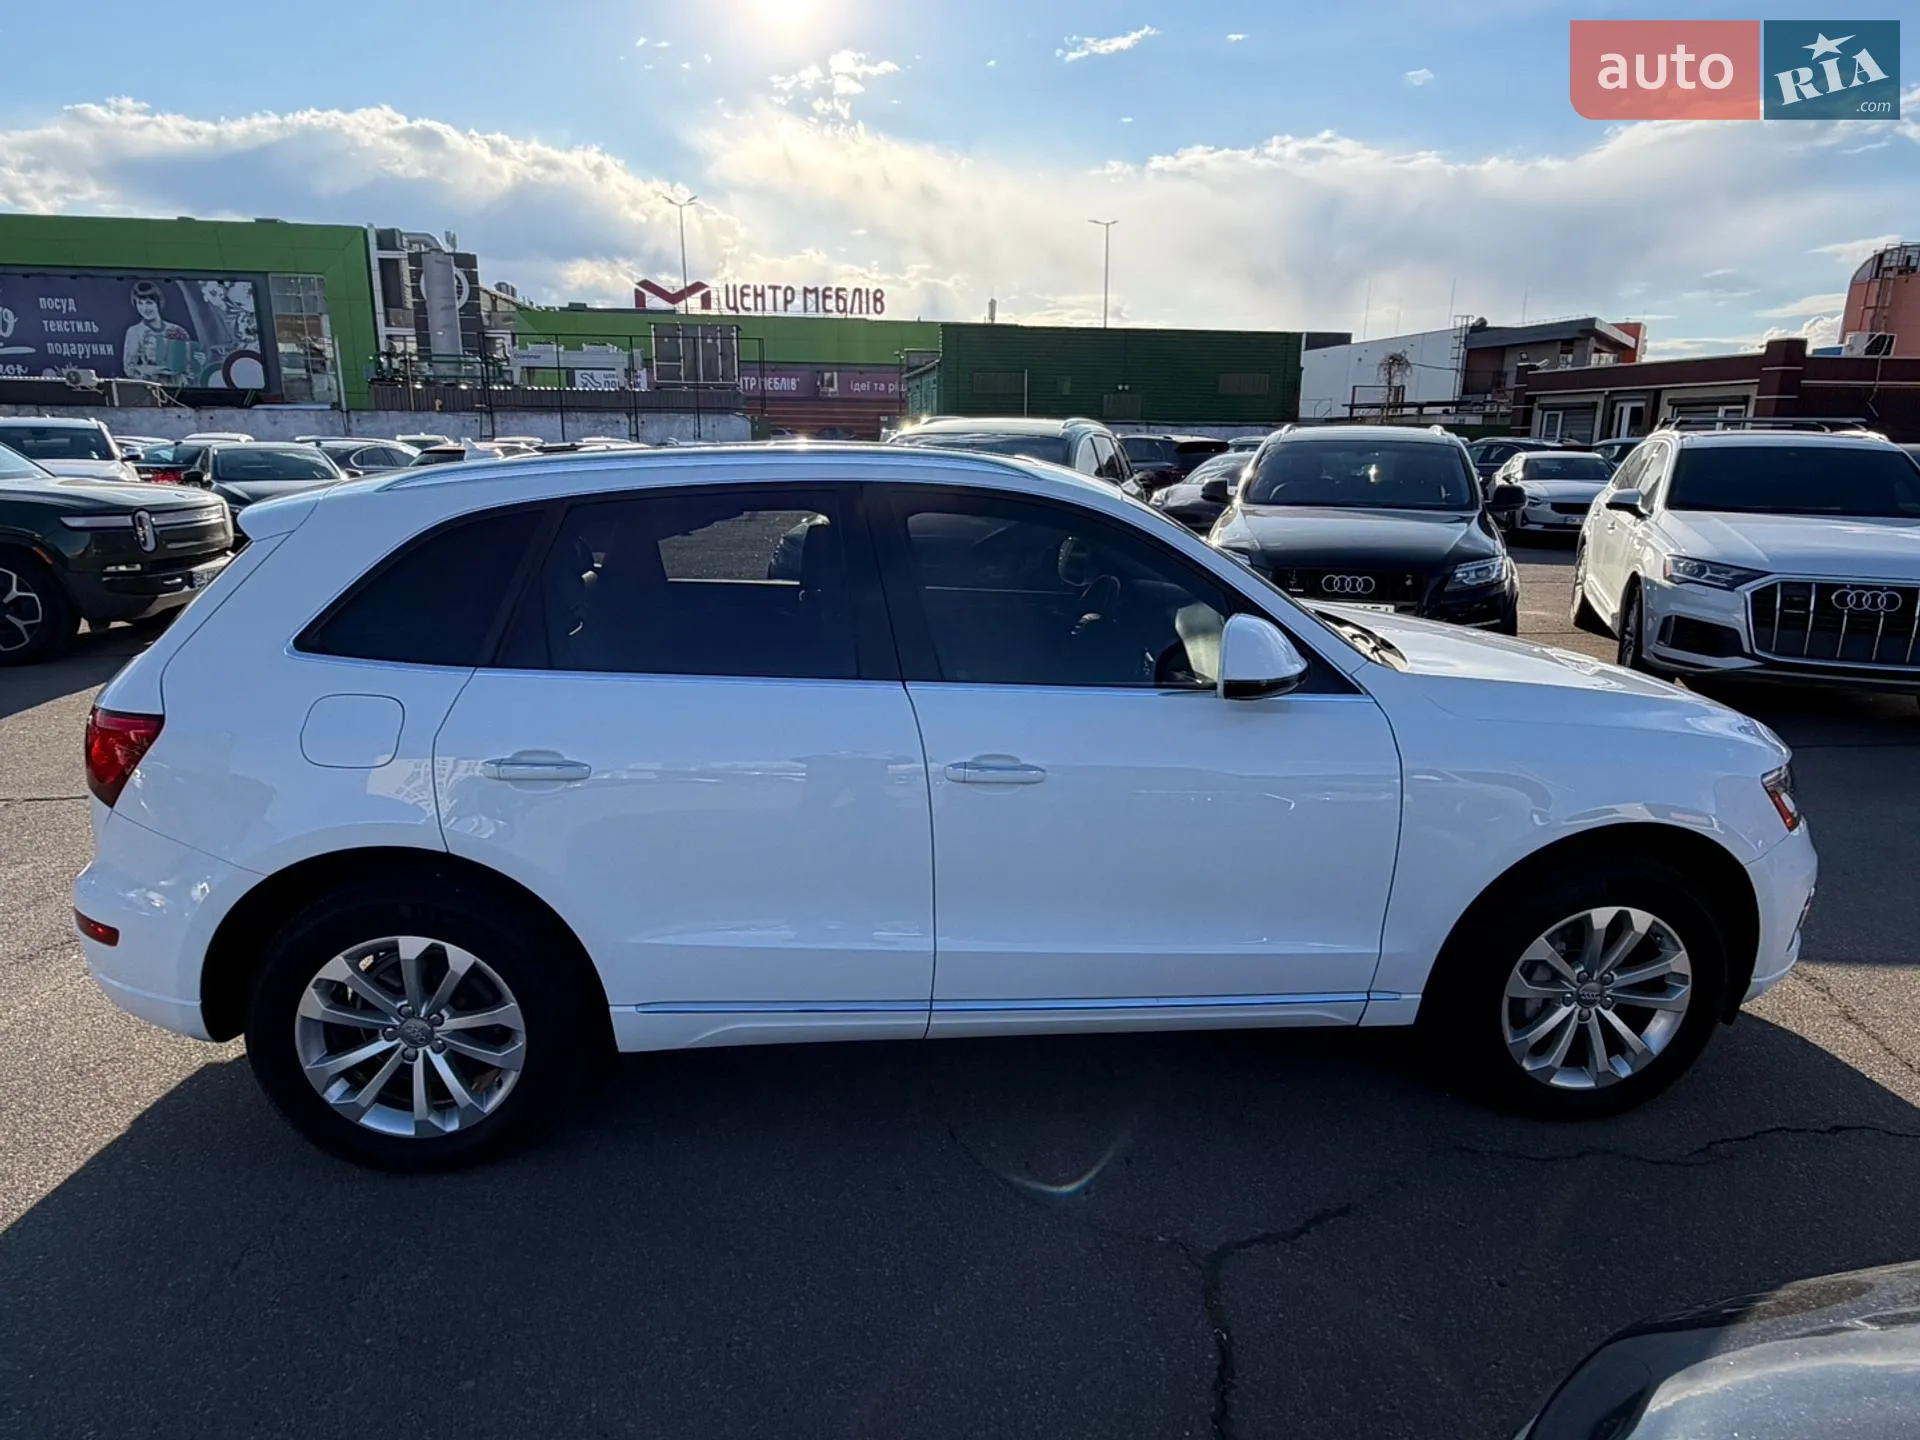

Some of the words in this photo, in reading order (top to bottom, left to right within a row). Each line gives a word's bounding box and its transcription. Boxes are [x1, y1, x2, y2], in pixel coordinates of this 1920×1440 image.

[39, 297, 77, 314] посуд
[725, 283, 796, 315] ЦЕНТР
[803, 286, 886, 315] МЕБЛІВ
[42, 320, 99, 333] текстиль
[46, 342, 114, 359] подарунки
